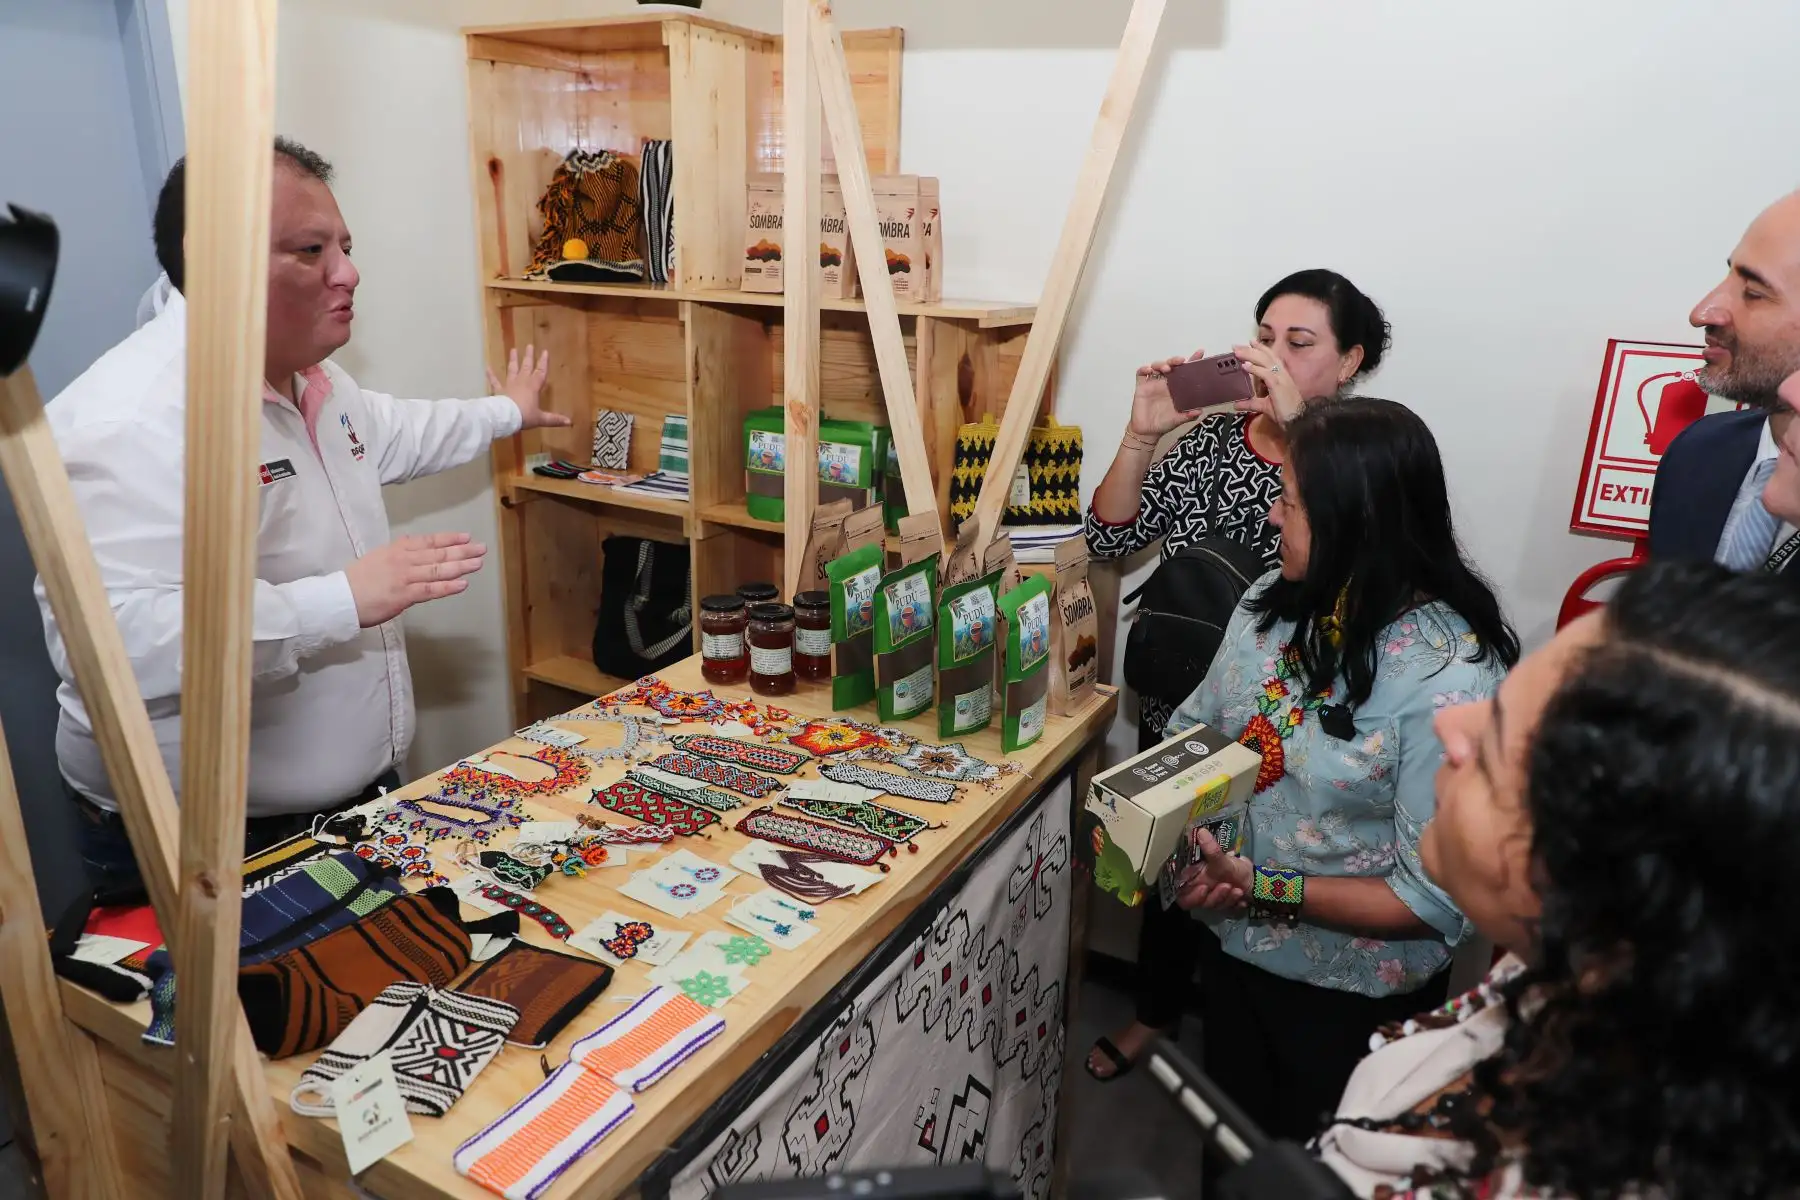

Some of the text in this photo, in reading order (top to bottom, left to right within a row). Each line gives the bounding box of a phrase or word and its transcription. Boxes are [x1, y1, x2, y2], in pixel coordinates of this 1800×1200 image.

[749, 214, 783, 230] SOMBRA
[820, 218, 844, 234] MBRA
[1600, 483, 1651, 506] EXTI
[1063, 595, 1093, 627] SOMBRA
